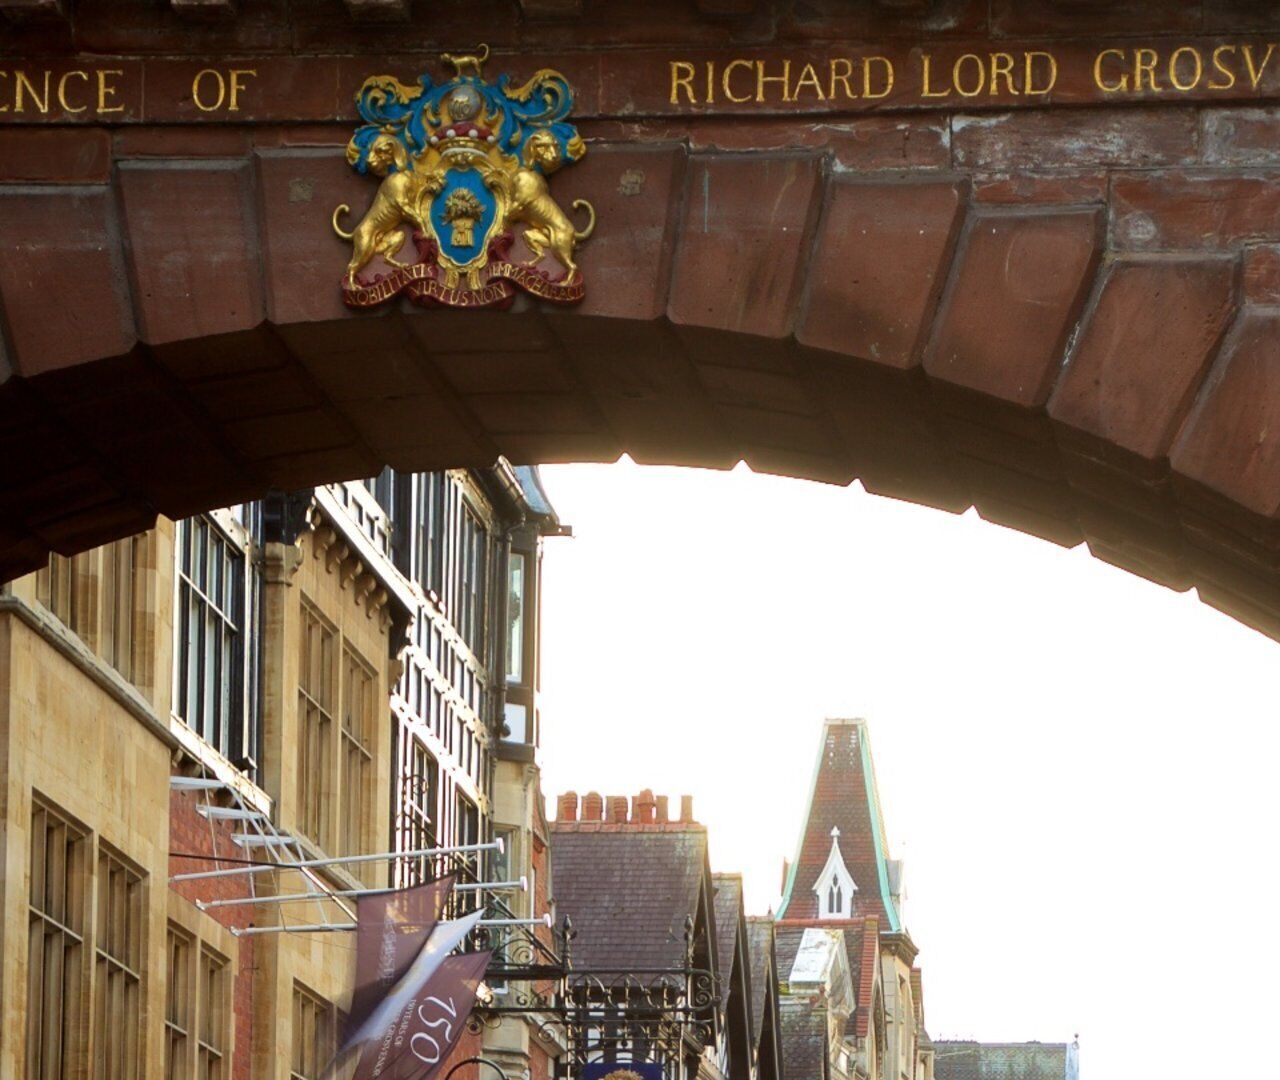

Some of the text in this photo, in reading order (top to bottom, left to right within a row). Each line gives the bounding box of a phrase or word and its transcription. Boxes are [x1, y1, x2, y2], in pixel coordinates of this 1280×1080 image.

[191, 68, 257, 112] OF
[669, 56, 894, 104] RICHARD
[921, 51, 1058, 98] LORD
[410, 995, 457, 1064] 150
